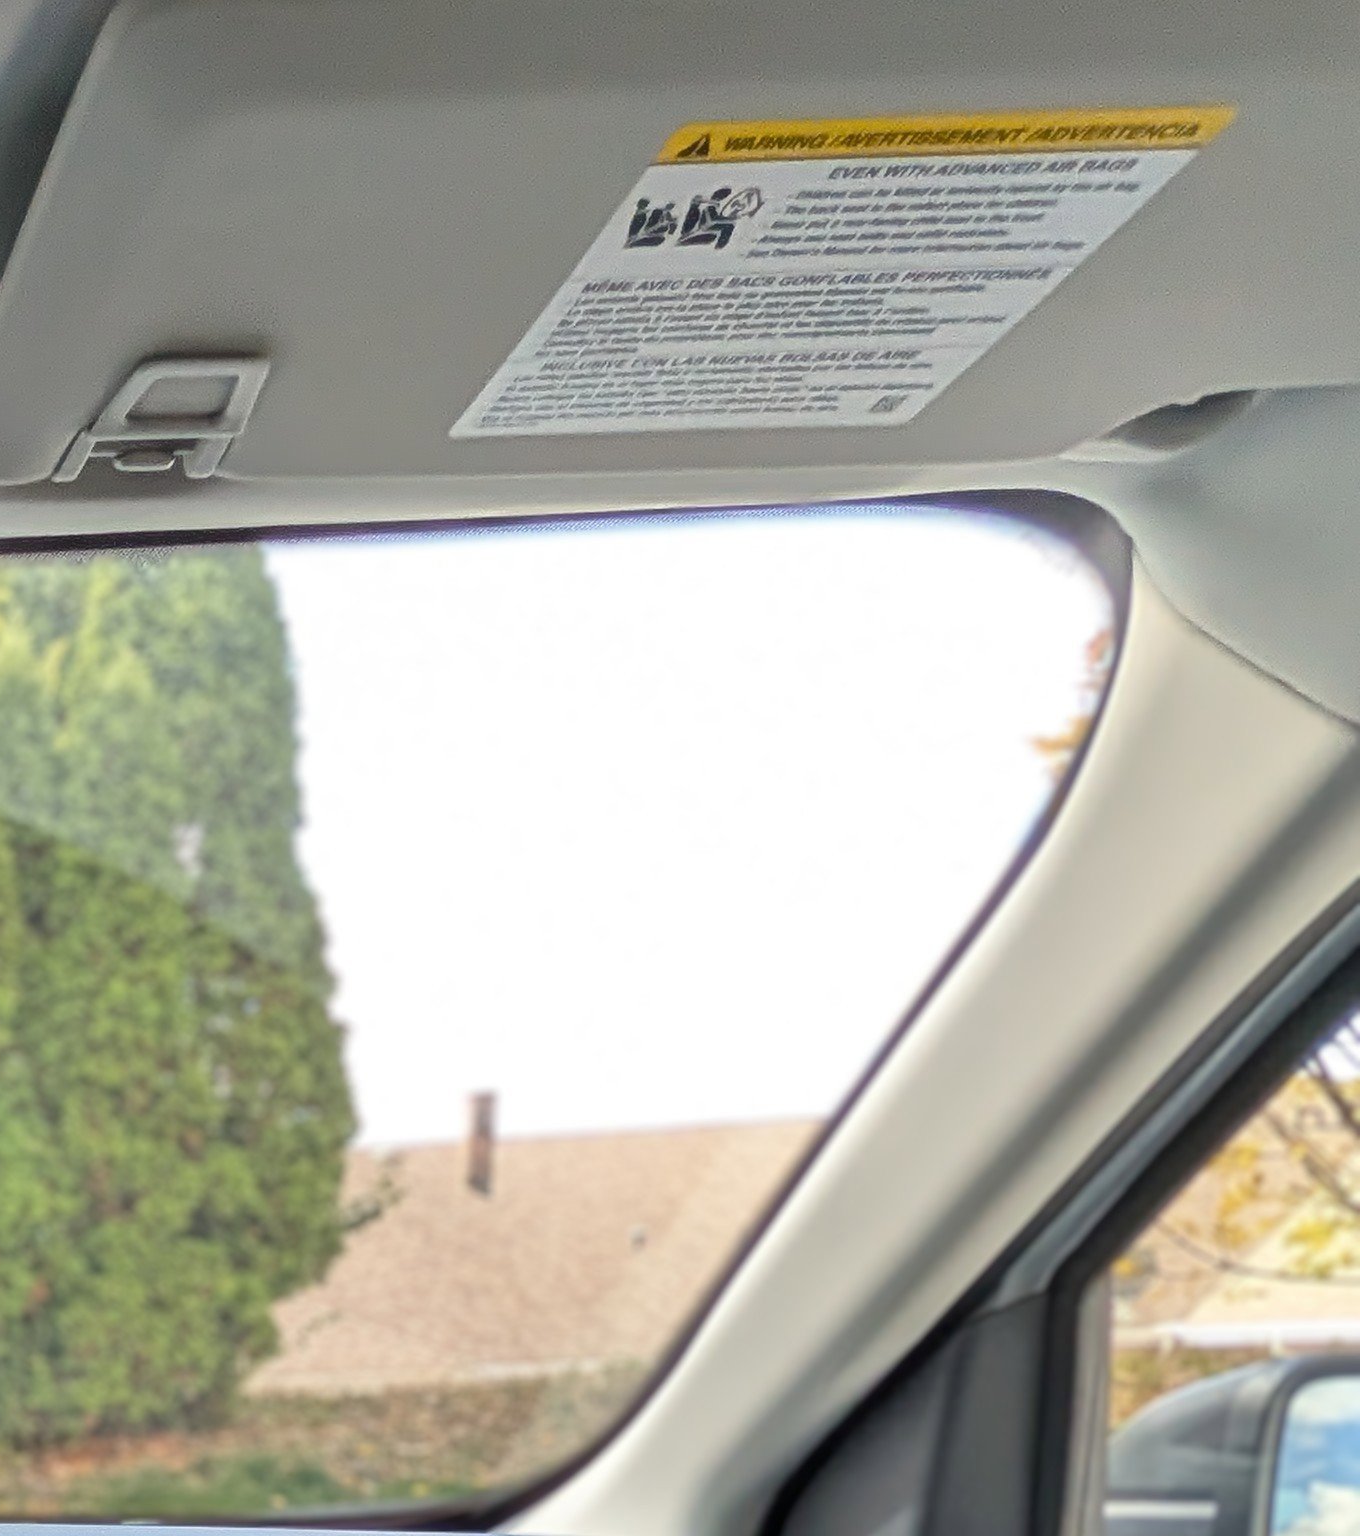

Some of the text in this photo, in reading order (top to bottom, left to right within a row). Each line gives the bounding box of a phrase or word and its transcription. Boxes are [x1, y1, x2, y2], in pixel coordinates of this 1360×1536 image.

[725, 132, 822, 151] WARNING
[829, 166, 881, 180] EVEN
[881, 164, 935, 179] WITH
[933, 161, 1043, 176] ADVANCED
